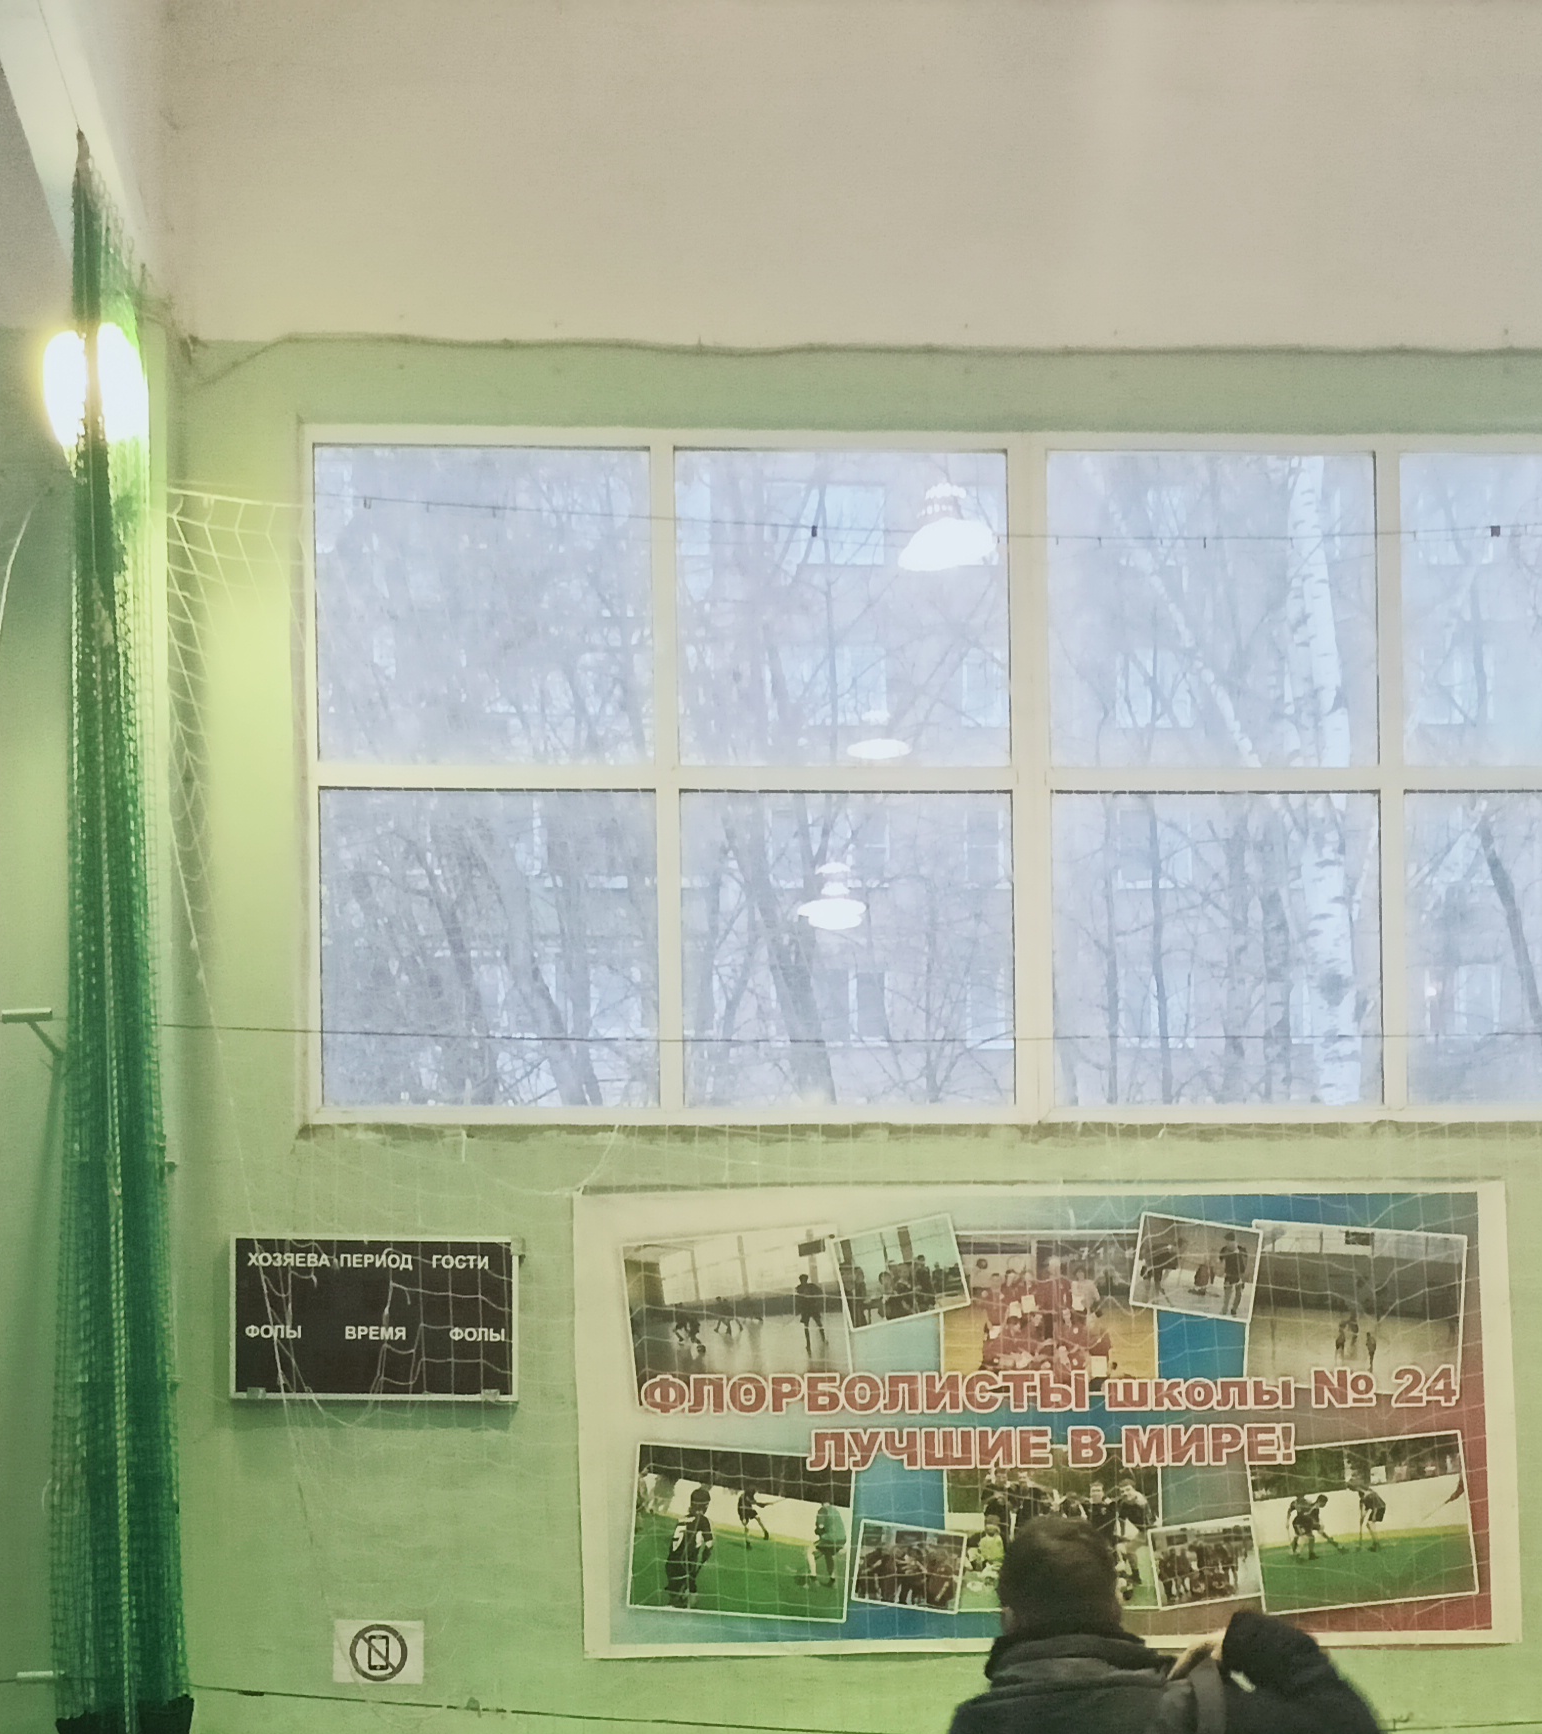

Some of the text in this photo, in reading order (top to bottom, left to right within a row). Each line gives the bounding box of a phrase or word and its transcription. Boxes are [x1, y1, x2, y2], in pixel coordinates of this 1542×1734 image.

[248, 1253, 489, 1271] ХОЗЯЕВА ПЕРИОД ГОСТИ
[245, 1325, 506, 1342] ФОЛЫ ВРЕМЯ ФОЛЫ
[642, 1365, 1458, 1415] ФЛОРБОЛИСТЫ школы № 24
[808, 1424, 1296, 1470] ЛУЧШИЕ В МИРЕ!
